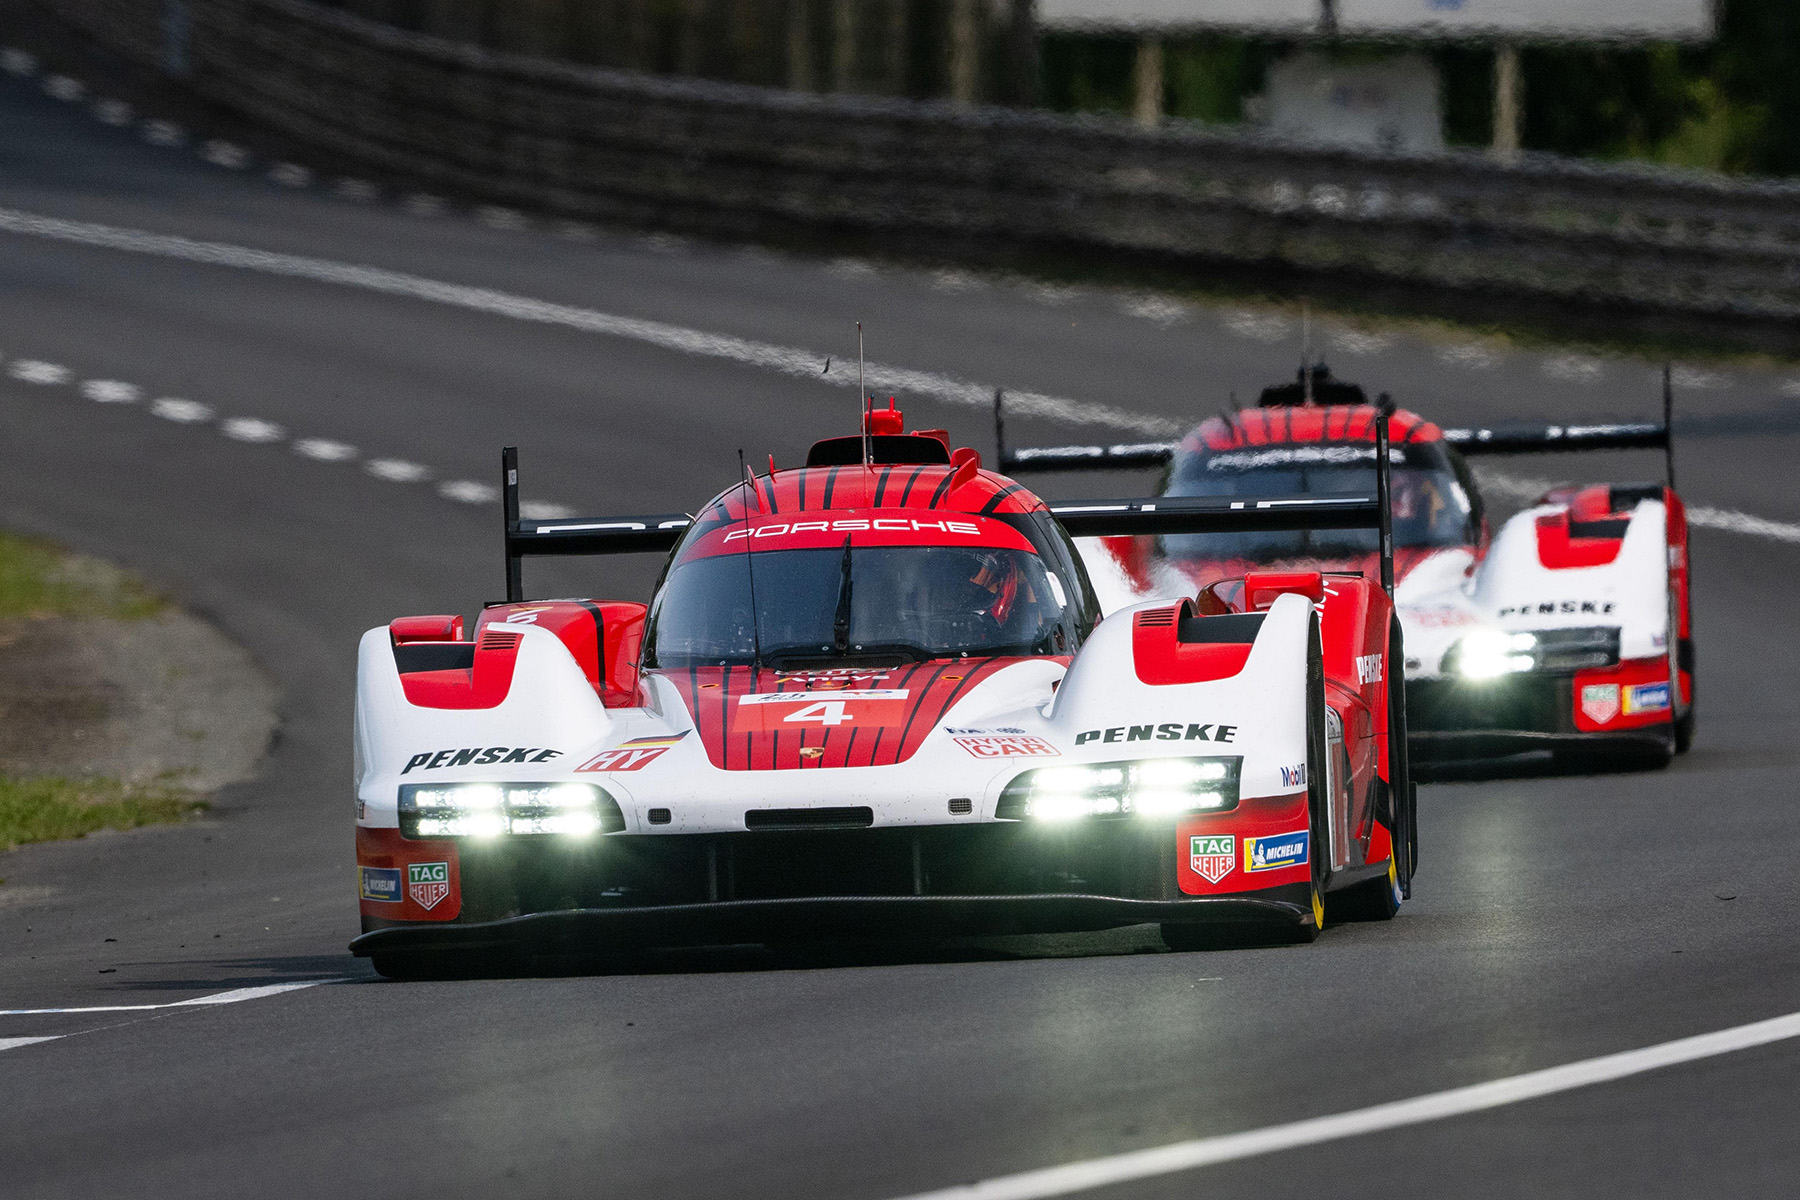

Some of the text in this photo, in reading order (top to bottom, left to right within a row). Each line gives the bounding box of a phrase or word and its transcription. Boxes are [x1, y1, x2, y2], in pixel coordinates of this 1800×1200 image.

[723, 519, 981, 543] PORSCHE
[783, 701, 853, 725] 4
[1075, 723, 1238, 746] PENSKE
[580, 749, 661, 771] HY
[972, 744, 1052, 756] CAR
[400, 747, 564, 776] PENSKE
[1194, 839, 1232, 854] TAG
[1266, 842, 1304, 860] MICHELIN
[411, 866, 444, 881] TAG
[1193, 856, 1233, 881] HEUER
[411, 884, 446, 906] HEUER
